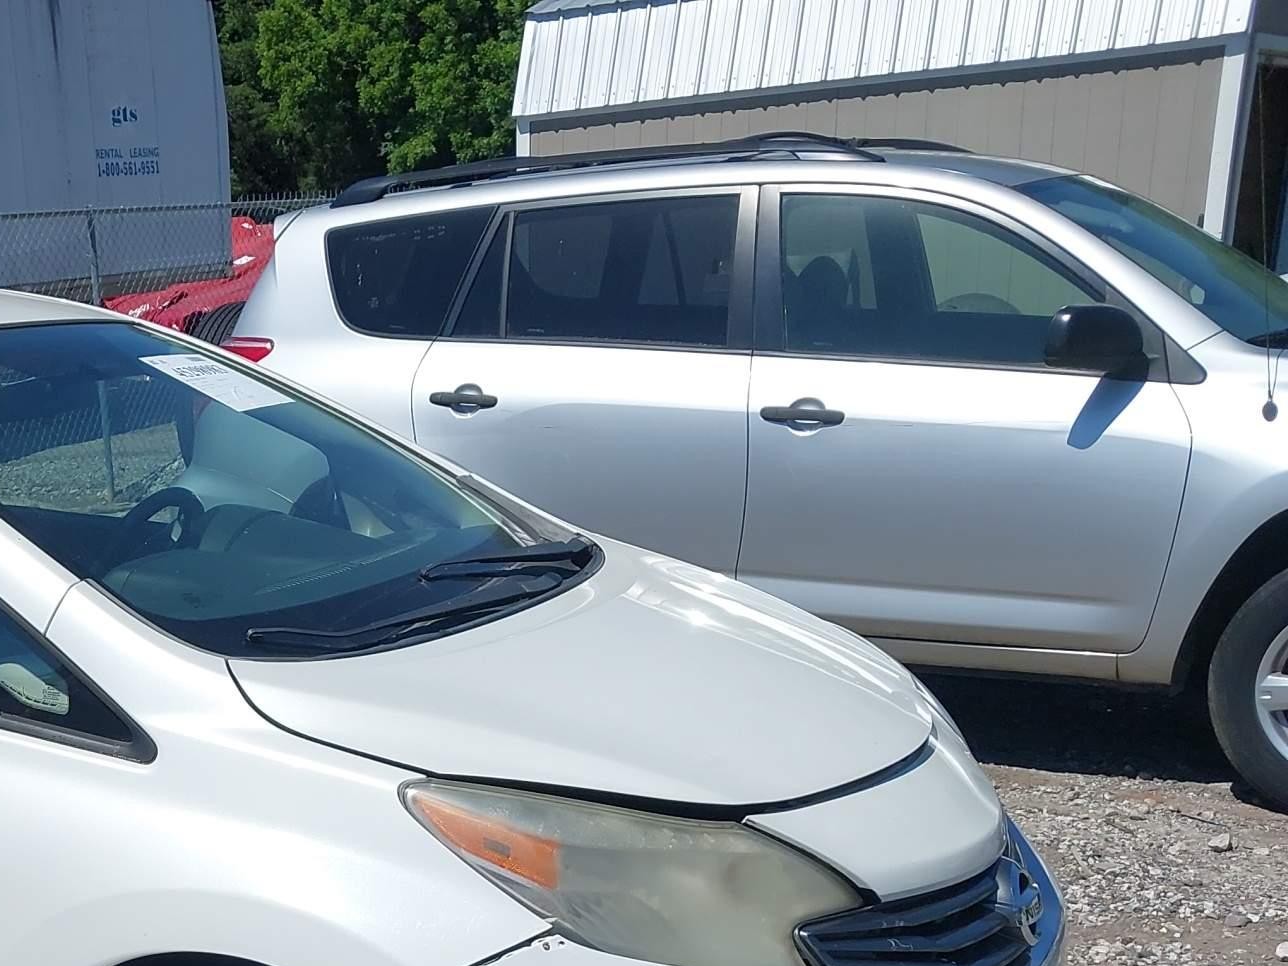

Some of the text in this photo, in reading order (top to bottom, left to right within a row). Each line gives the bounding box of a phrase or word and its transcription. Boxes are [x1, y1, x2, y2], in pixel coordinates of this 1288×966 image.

[112, 106, 138, 128] gts
[95, 146, 160, 159] RENTAL LEASING
